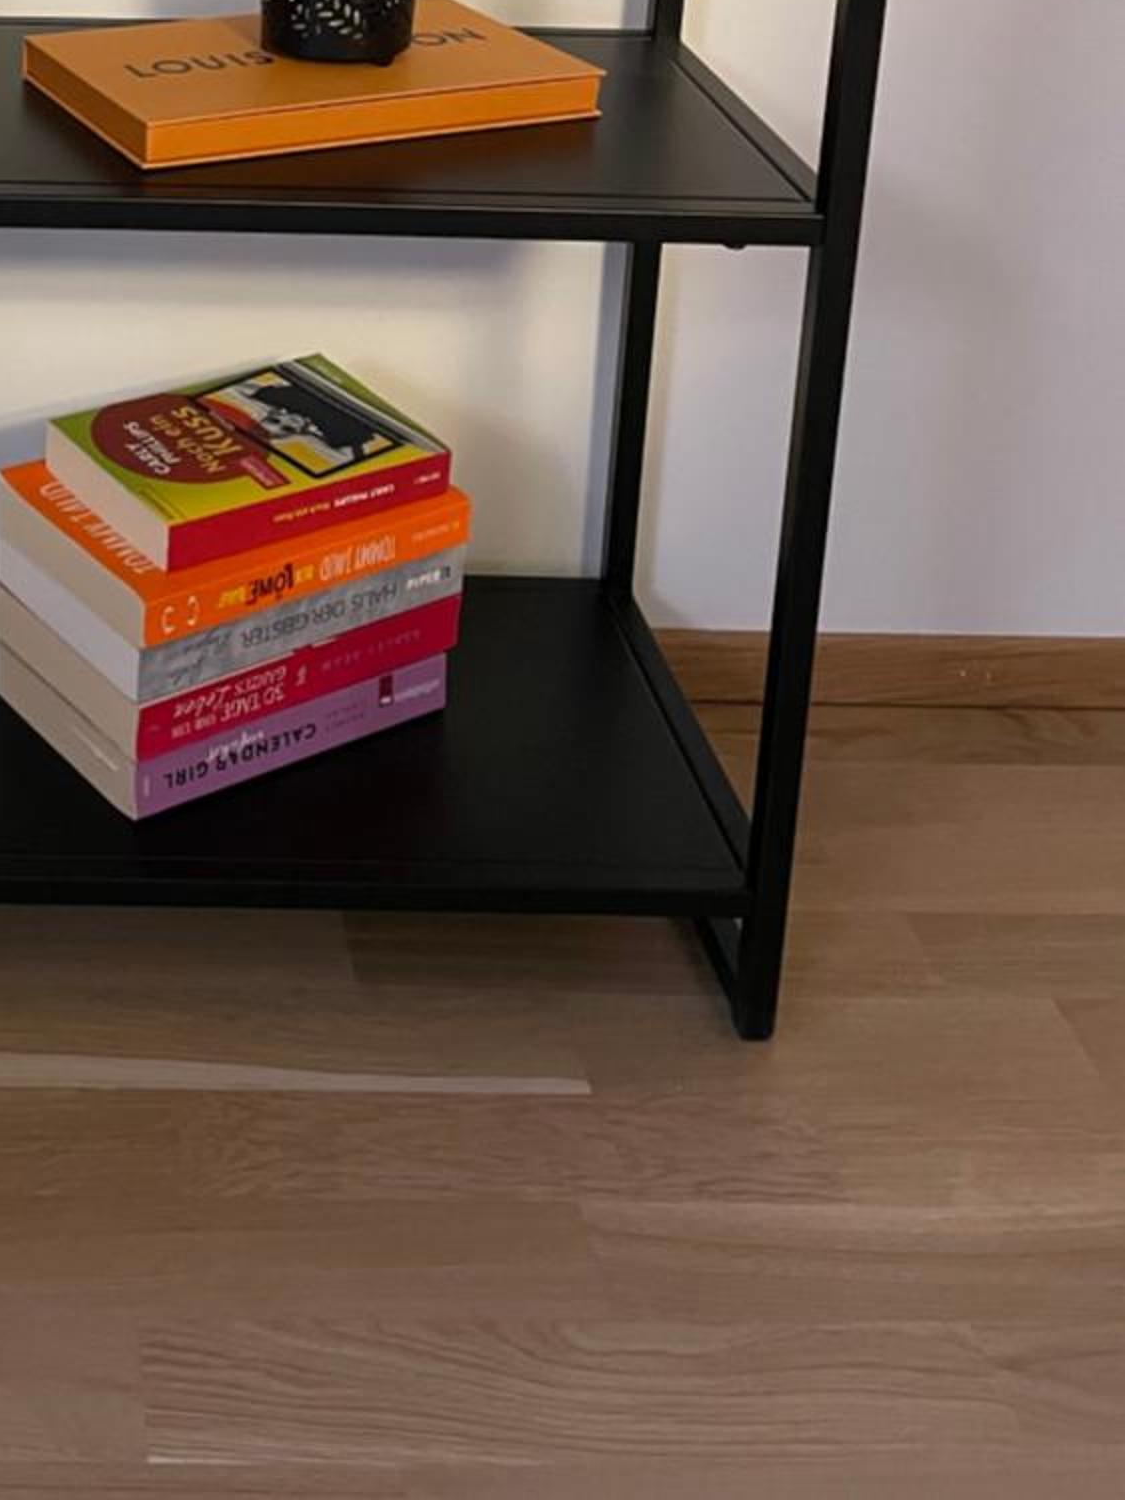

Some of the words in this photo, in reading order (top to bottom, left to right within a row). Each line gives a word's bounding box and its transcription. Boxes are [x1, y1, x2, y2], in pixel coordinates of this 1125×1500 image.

[125, 51, 273, 78] LOUIS
[150, 414, 182, 438] ein
[177, 438, 225, 473] Noch
[352, 584, 397, 610] HAUS
[312, 599, 346, 623] DER
[216, 723, 316, 771] CALENDAR
[163, 761, 209, 788] GIRL
